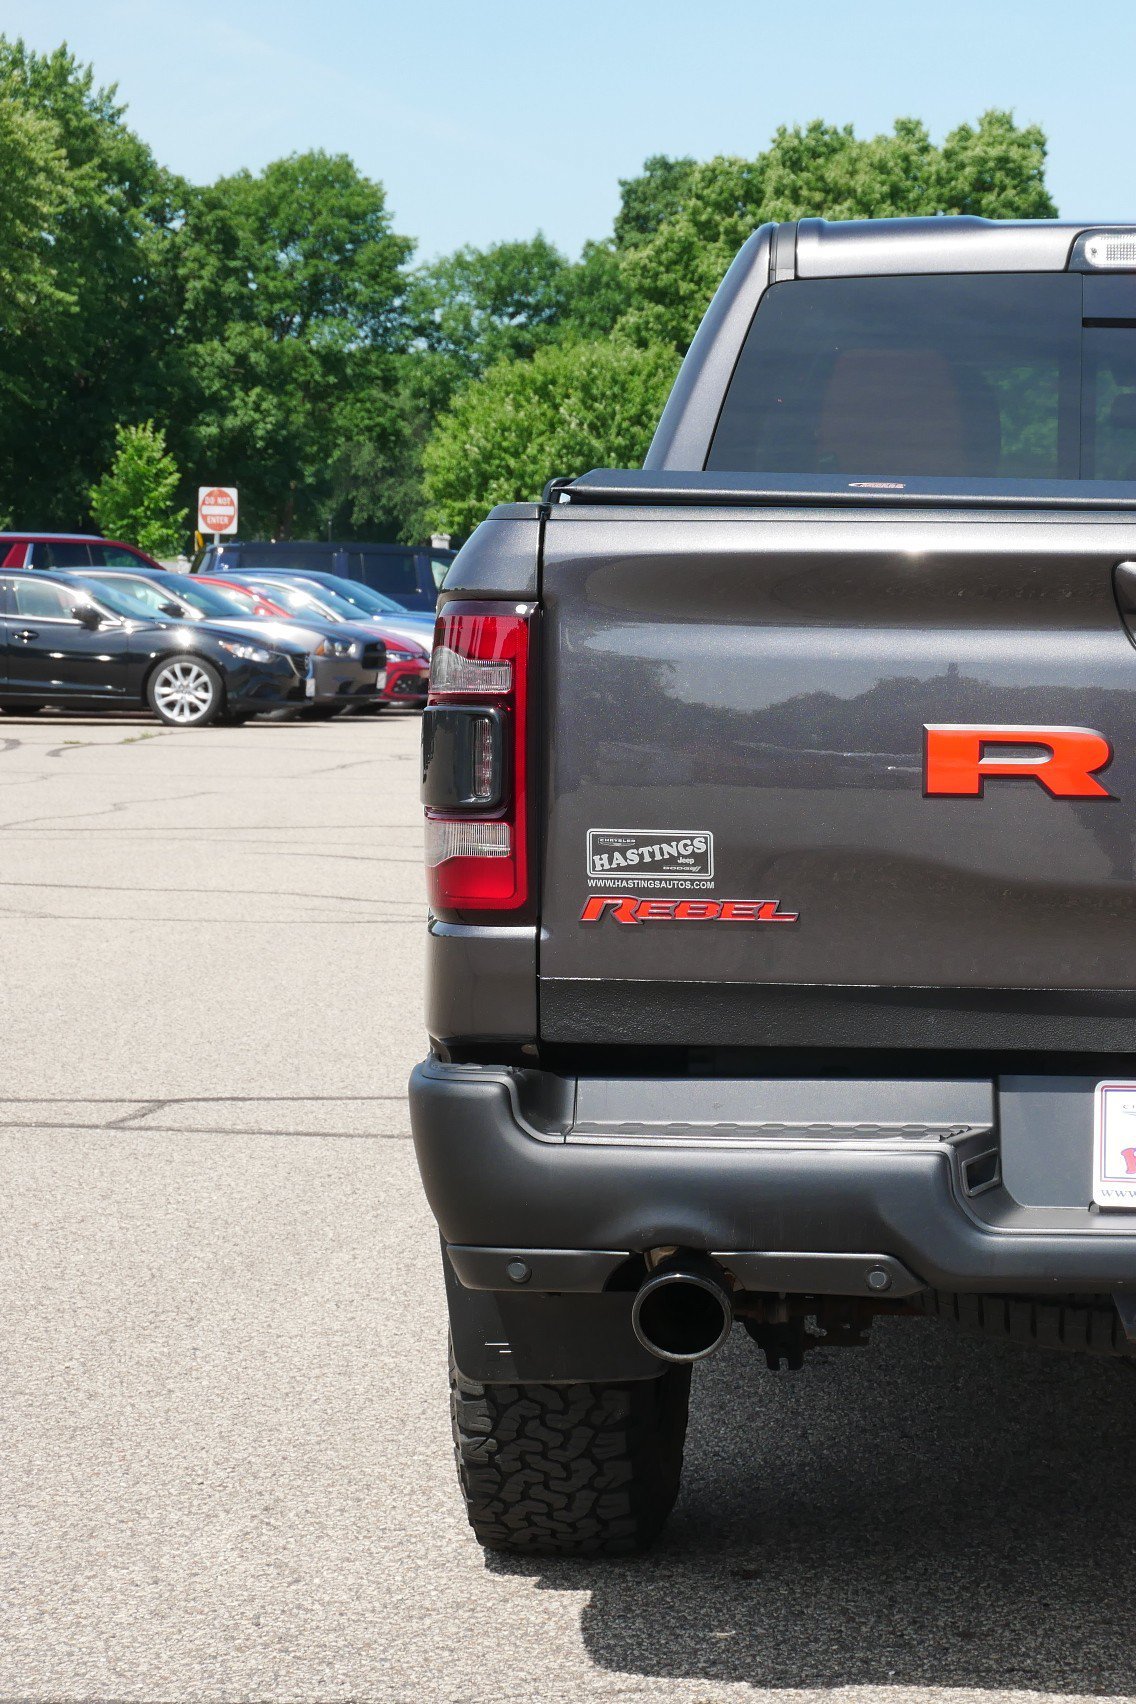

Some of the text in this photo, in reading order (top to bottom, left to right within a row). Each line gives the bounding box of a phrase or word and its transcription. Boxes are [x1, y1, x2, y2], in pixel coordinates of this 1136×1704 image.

[204, 496, 231, 505] DO NOT
[206, 516, 229, 525] ENTER
[593, 837, 707, 872] HASTINGS
[677, 857, 695, 865] Jeep
[587, 879, 715, 889] WWW.HASTINGSAUTOS.COM
